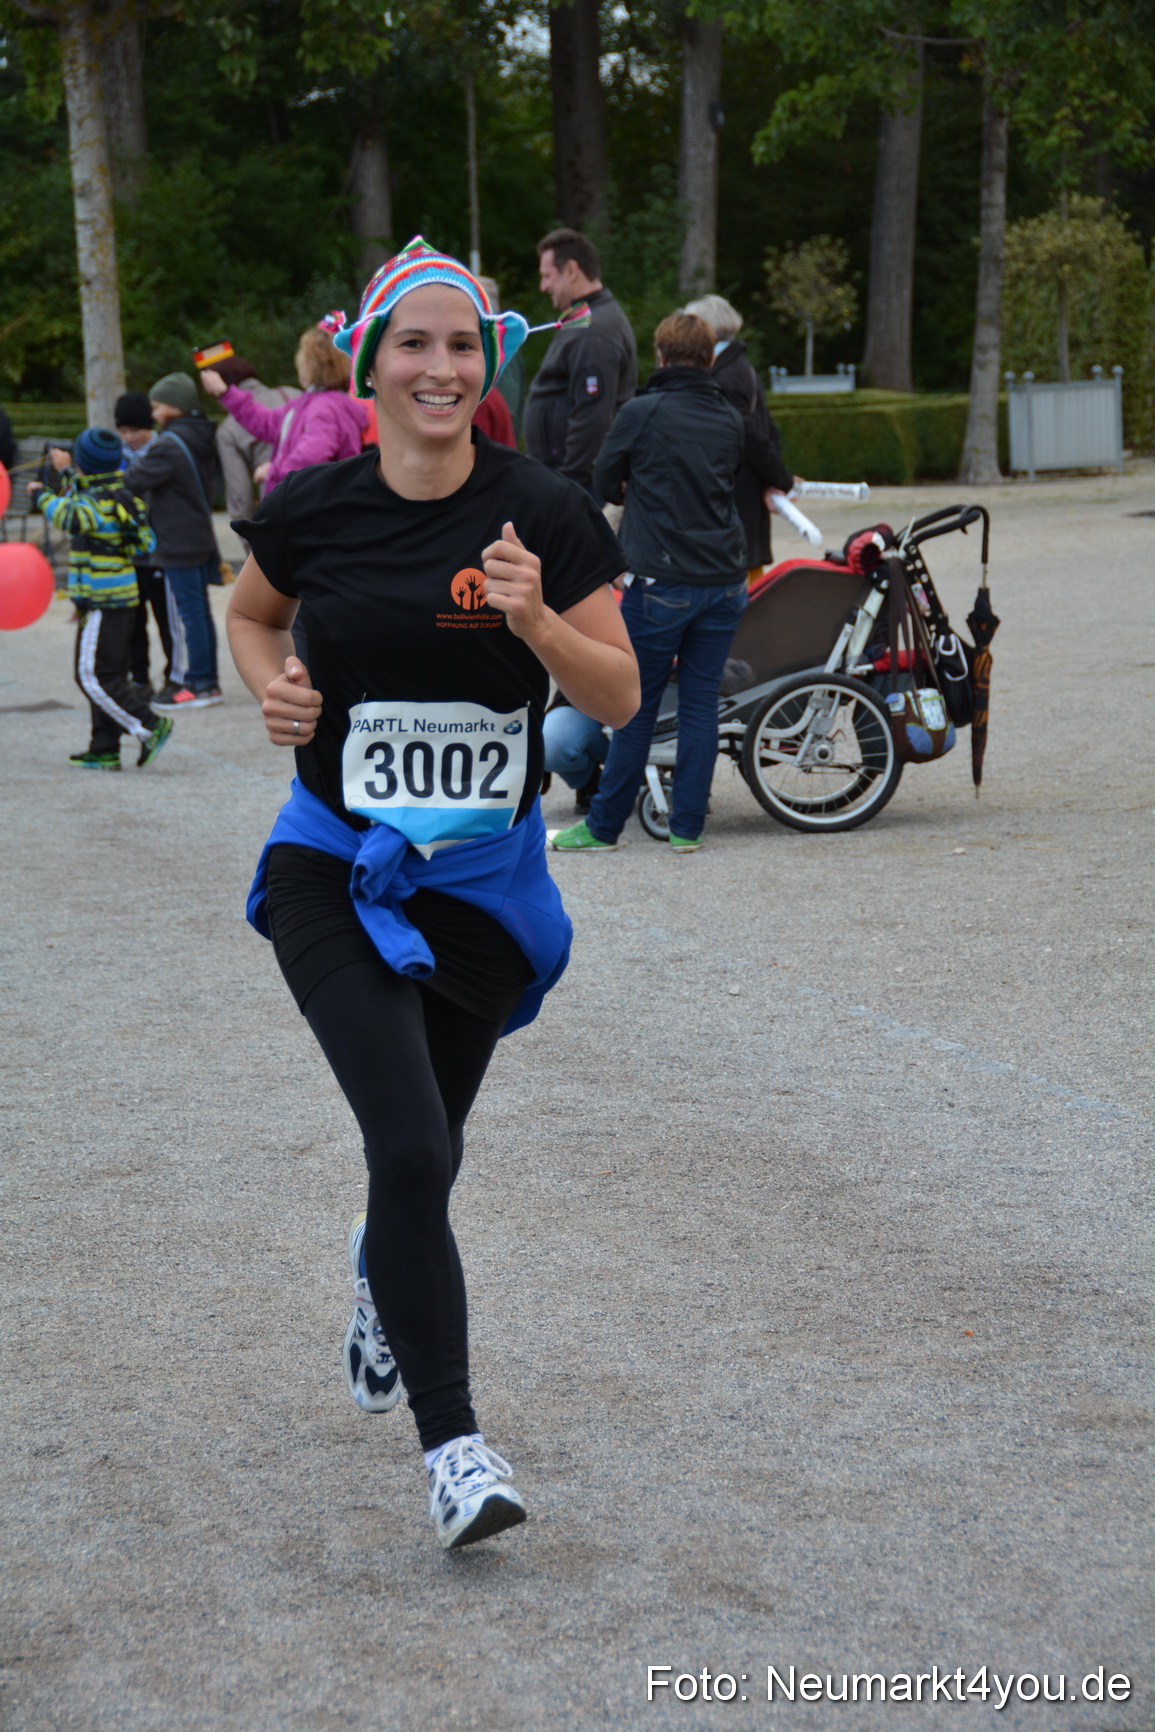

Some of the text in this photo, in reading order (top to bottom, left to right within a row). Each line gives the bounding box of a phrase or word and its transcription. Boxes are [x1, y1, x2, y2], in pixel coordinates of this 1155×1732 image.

[351, 718, 496, 733] PARTL Neumarkt
[364, 740, 509, 800] 3002
